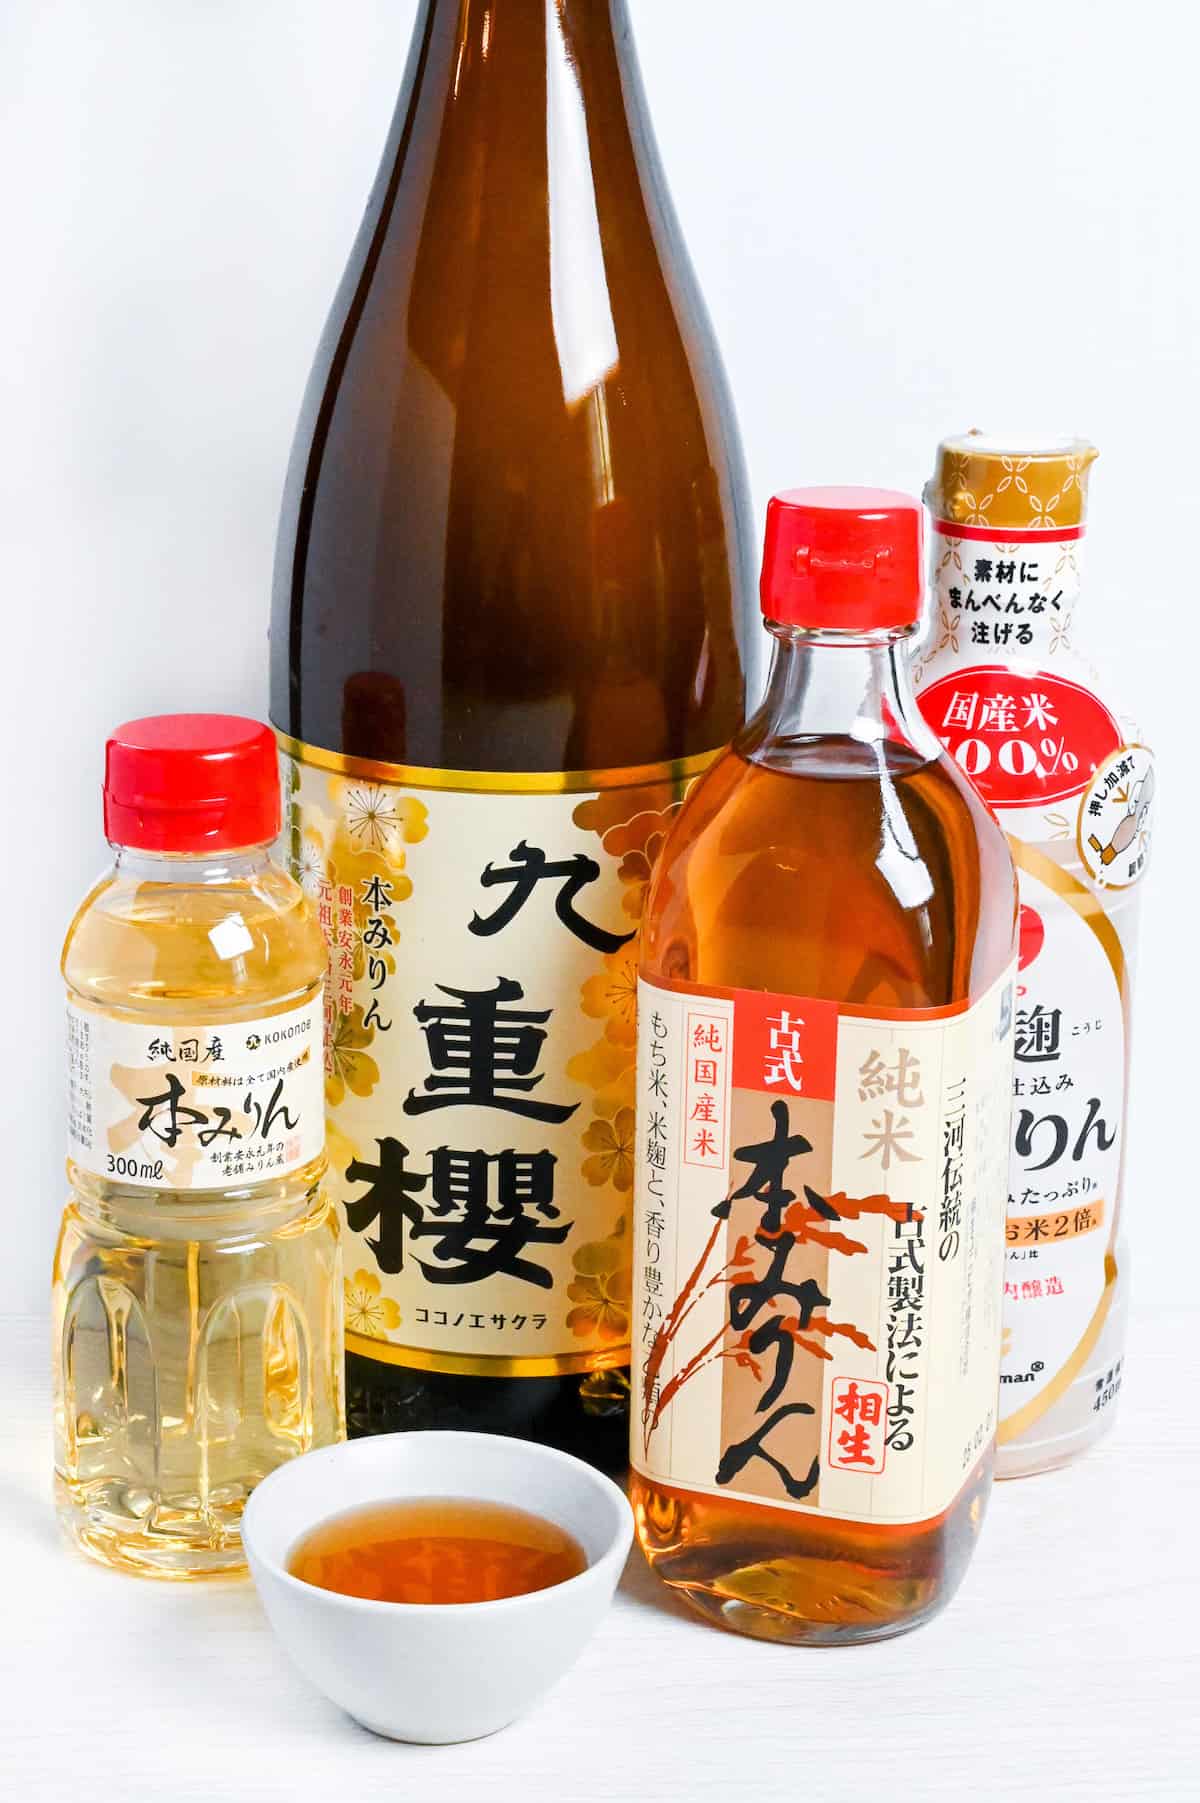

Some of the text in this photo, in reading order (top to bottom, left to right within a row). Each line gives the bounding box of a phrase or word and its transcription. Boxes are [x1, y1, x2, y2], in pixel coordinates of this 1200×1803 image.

[949, 587, 1064, 614] まんべんなく
[974, 559, 1039, 584] 素材に
[971, 621, 1034, 645] 注げる
[942, 691, 1060, 733] 国産米
[361, 875, 393, 1032] 本みりん
[146, 1036, 225, 1063] 純国産
[762, 1010, 807, 1092] 古式
[1071, 1019, 1103, 1037] こうじ
[136, 1072, 301, 1149] 本みりん
[689, 1023, 723, 1158] 純国産米
[857, 1047, 925, 1172] 純米
[938, 1077, 967, 1262] 三河伝統の
[415, 1307, 548, 1332] ココノエサクラ
[711, 1099, 841, 1499] 本みりん
[834, 1381, 884, 1466] 相生
